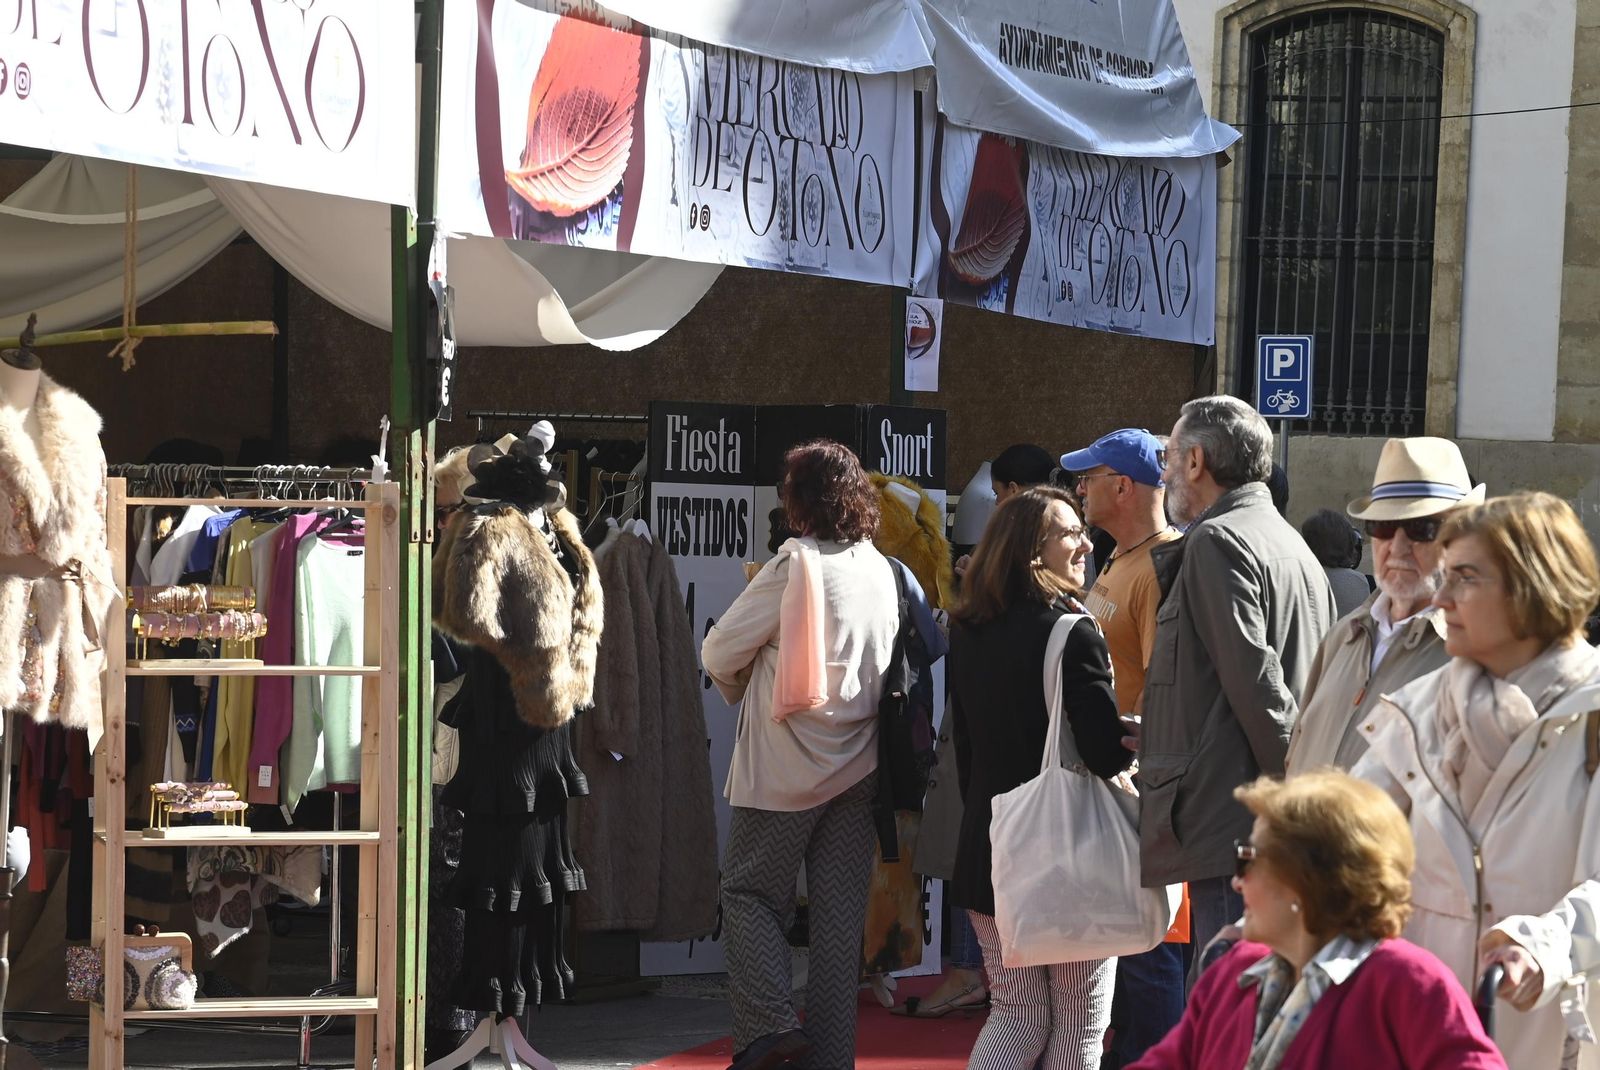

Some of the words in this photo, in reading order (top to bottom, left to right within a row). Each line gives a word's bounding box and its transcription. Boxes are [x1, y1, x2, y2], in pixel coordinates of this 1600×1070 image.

[999, 22, 1090, 82] AYUNTAMIENTO
[692, 117, 738, 192] DE
[1058, 214, 1083, 272] DE
[1273, 348, 1295, 376] P
[665, 414, 742, 475] Fiesta
[880, 418, 934, 478] Sport
[656, 496, 748, 558] VESTIDOS
